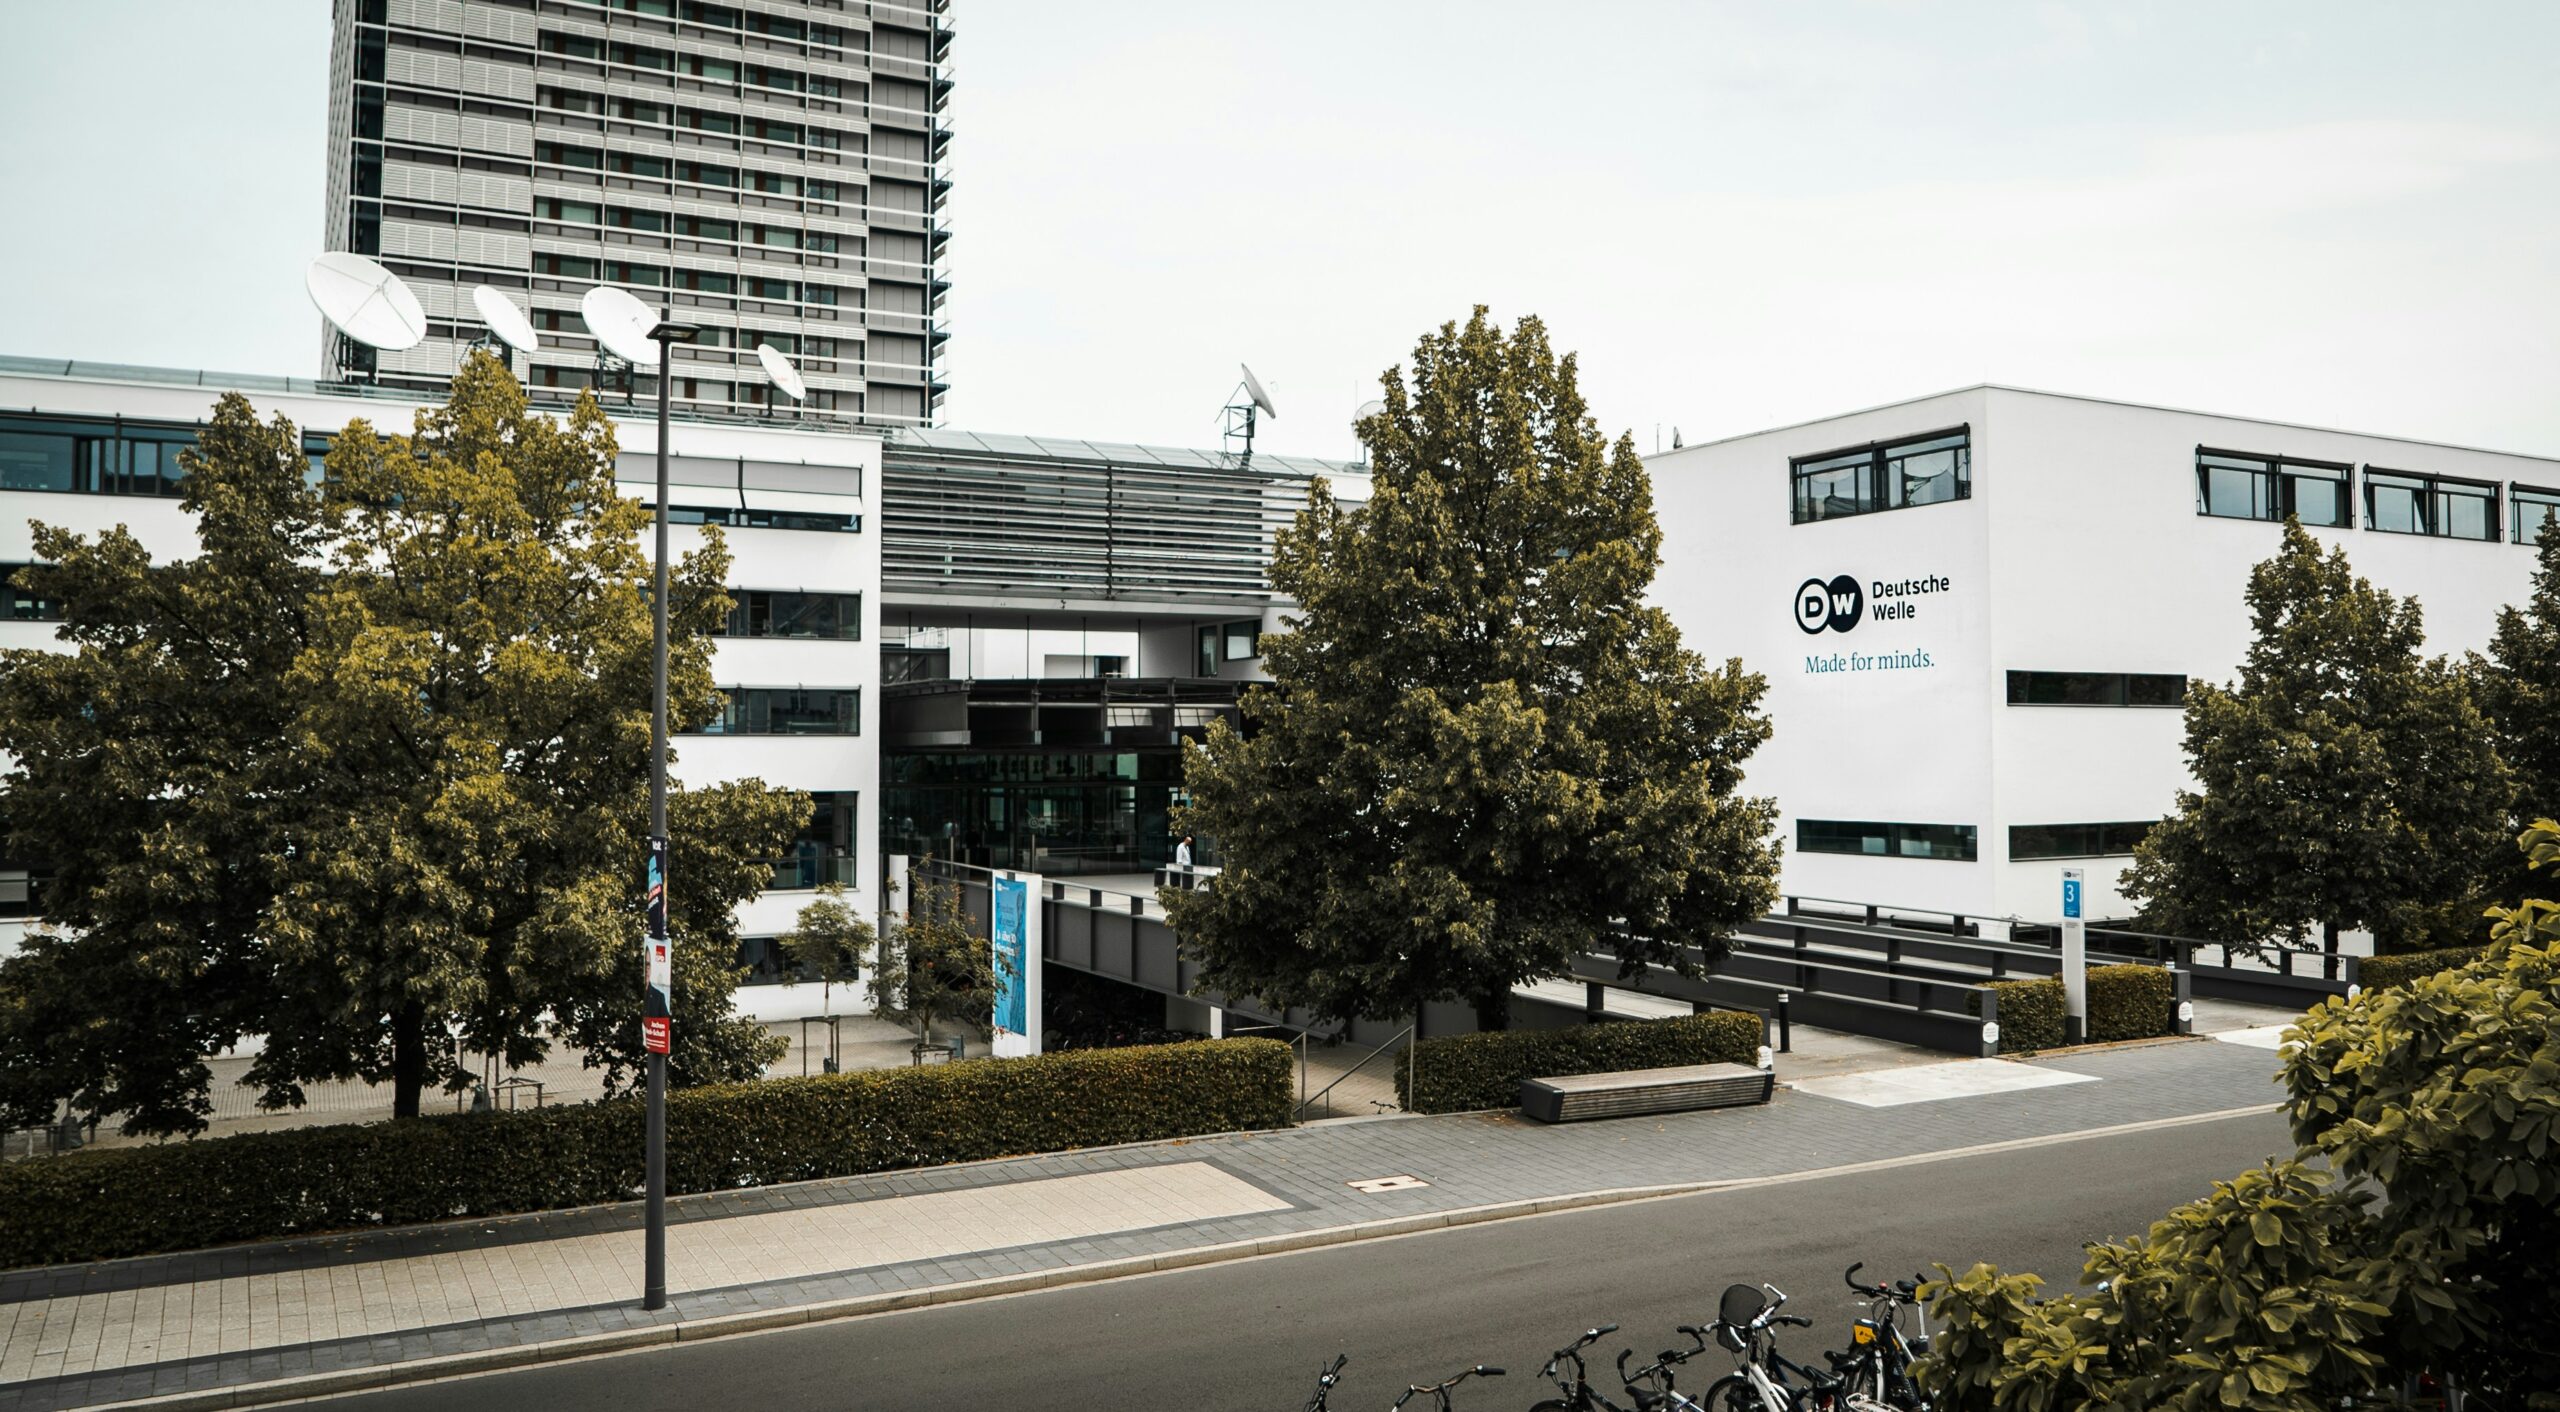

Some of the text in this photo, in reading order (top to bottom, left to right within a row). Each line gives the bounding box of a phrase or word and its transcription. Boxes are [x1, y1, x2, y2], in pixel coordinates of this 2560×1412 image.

[1872, 574, 1950, 599] Deutsche
[1872, 601, 1916, 621] Welle
[1805, 648, 1935, 674] Made for minds.
[2066, 884, 2075, 903] 3
